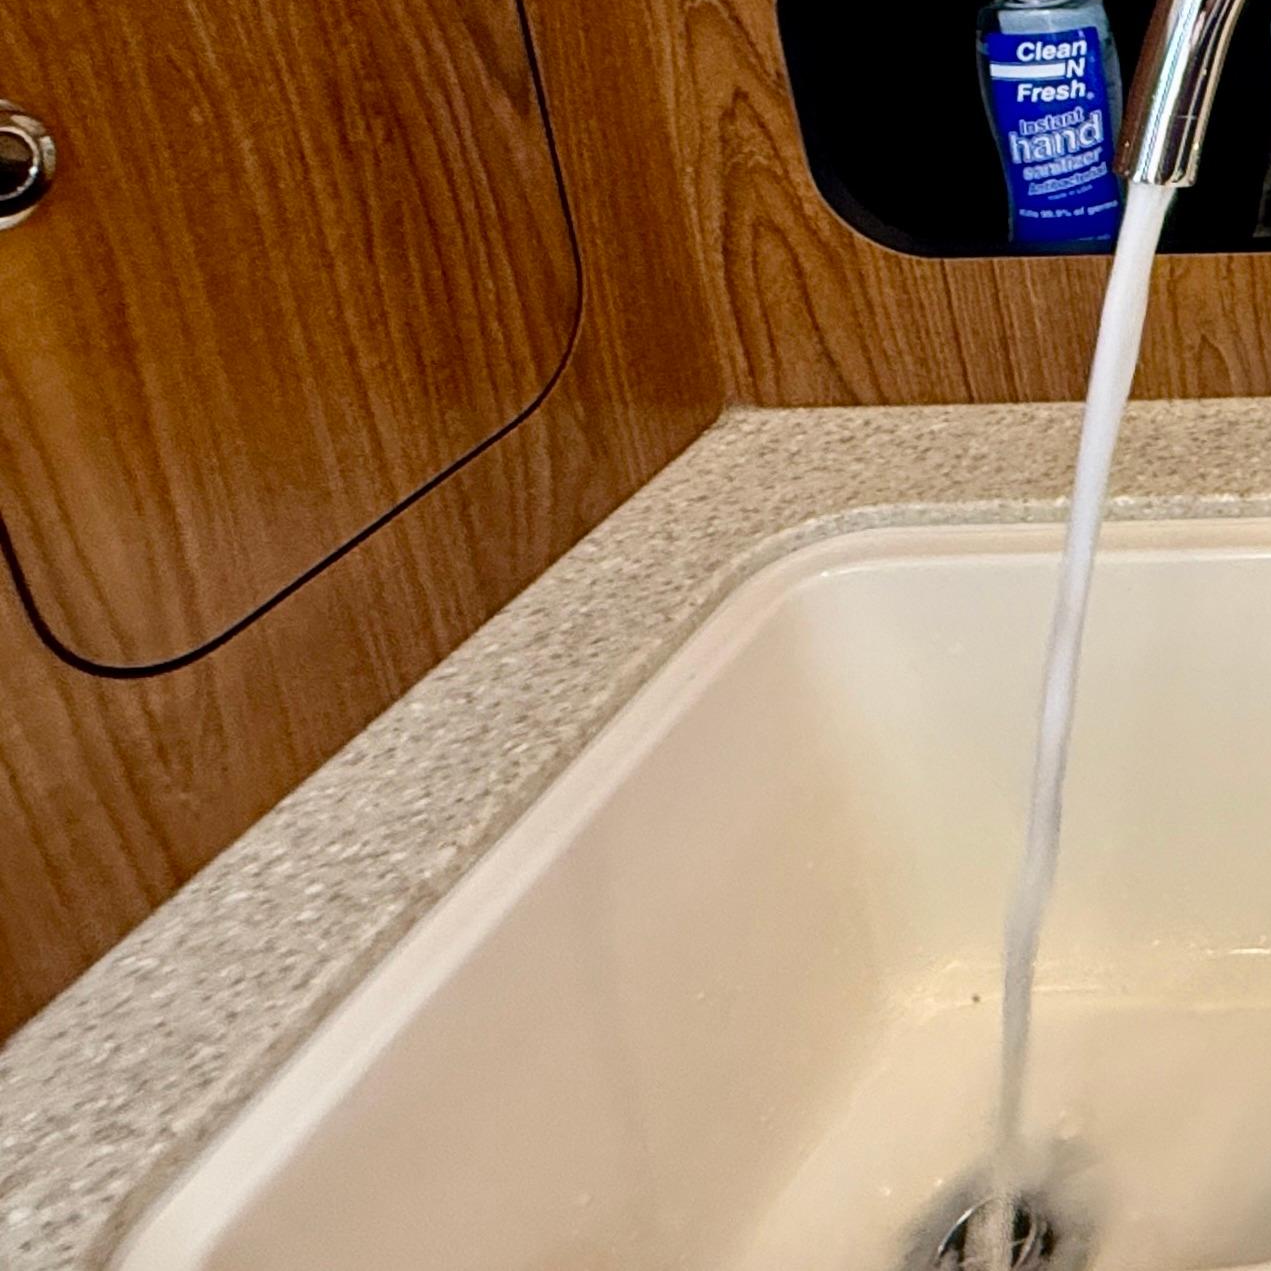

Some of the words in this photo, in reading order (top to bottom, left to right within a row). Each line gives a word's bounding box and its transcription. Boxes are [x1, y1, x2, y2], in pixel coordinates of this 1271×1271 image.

[1016, 39, 1088, 62] Clean
[1066, 58, 1086, 78] N
[1016, 81, 1086, 102] Fresh
[1018, 105, 1085, 136] Instant
[1008, 109, 1104, 165] hand
